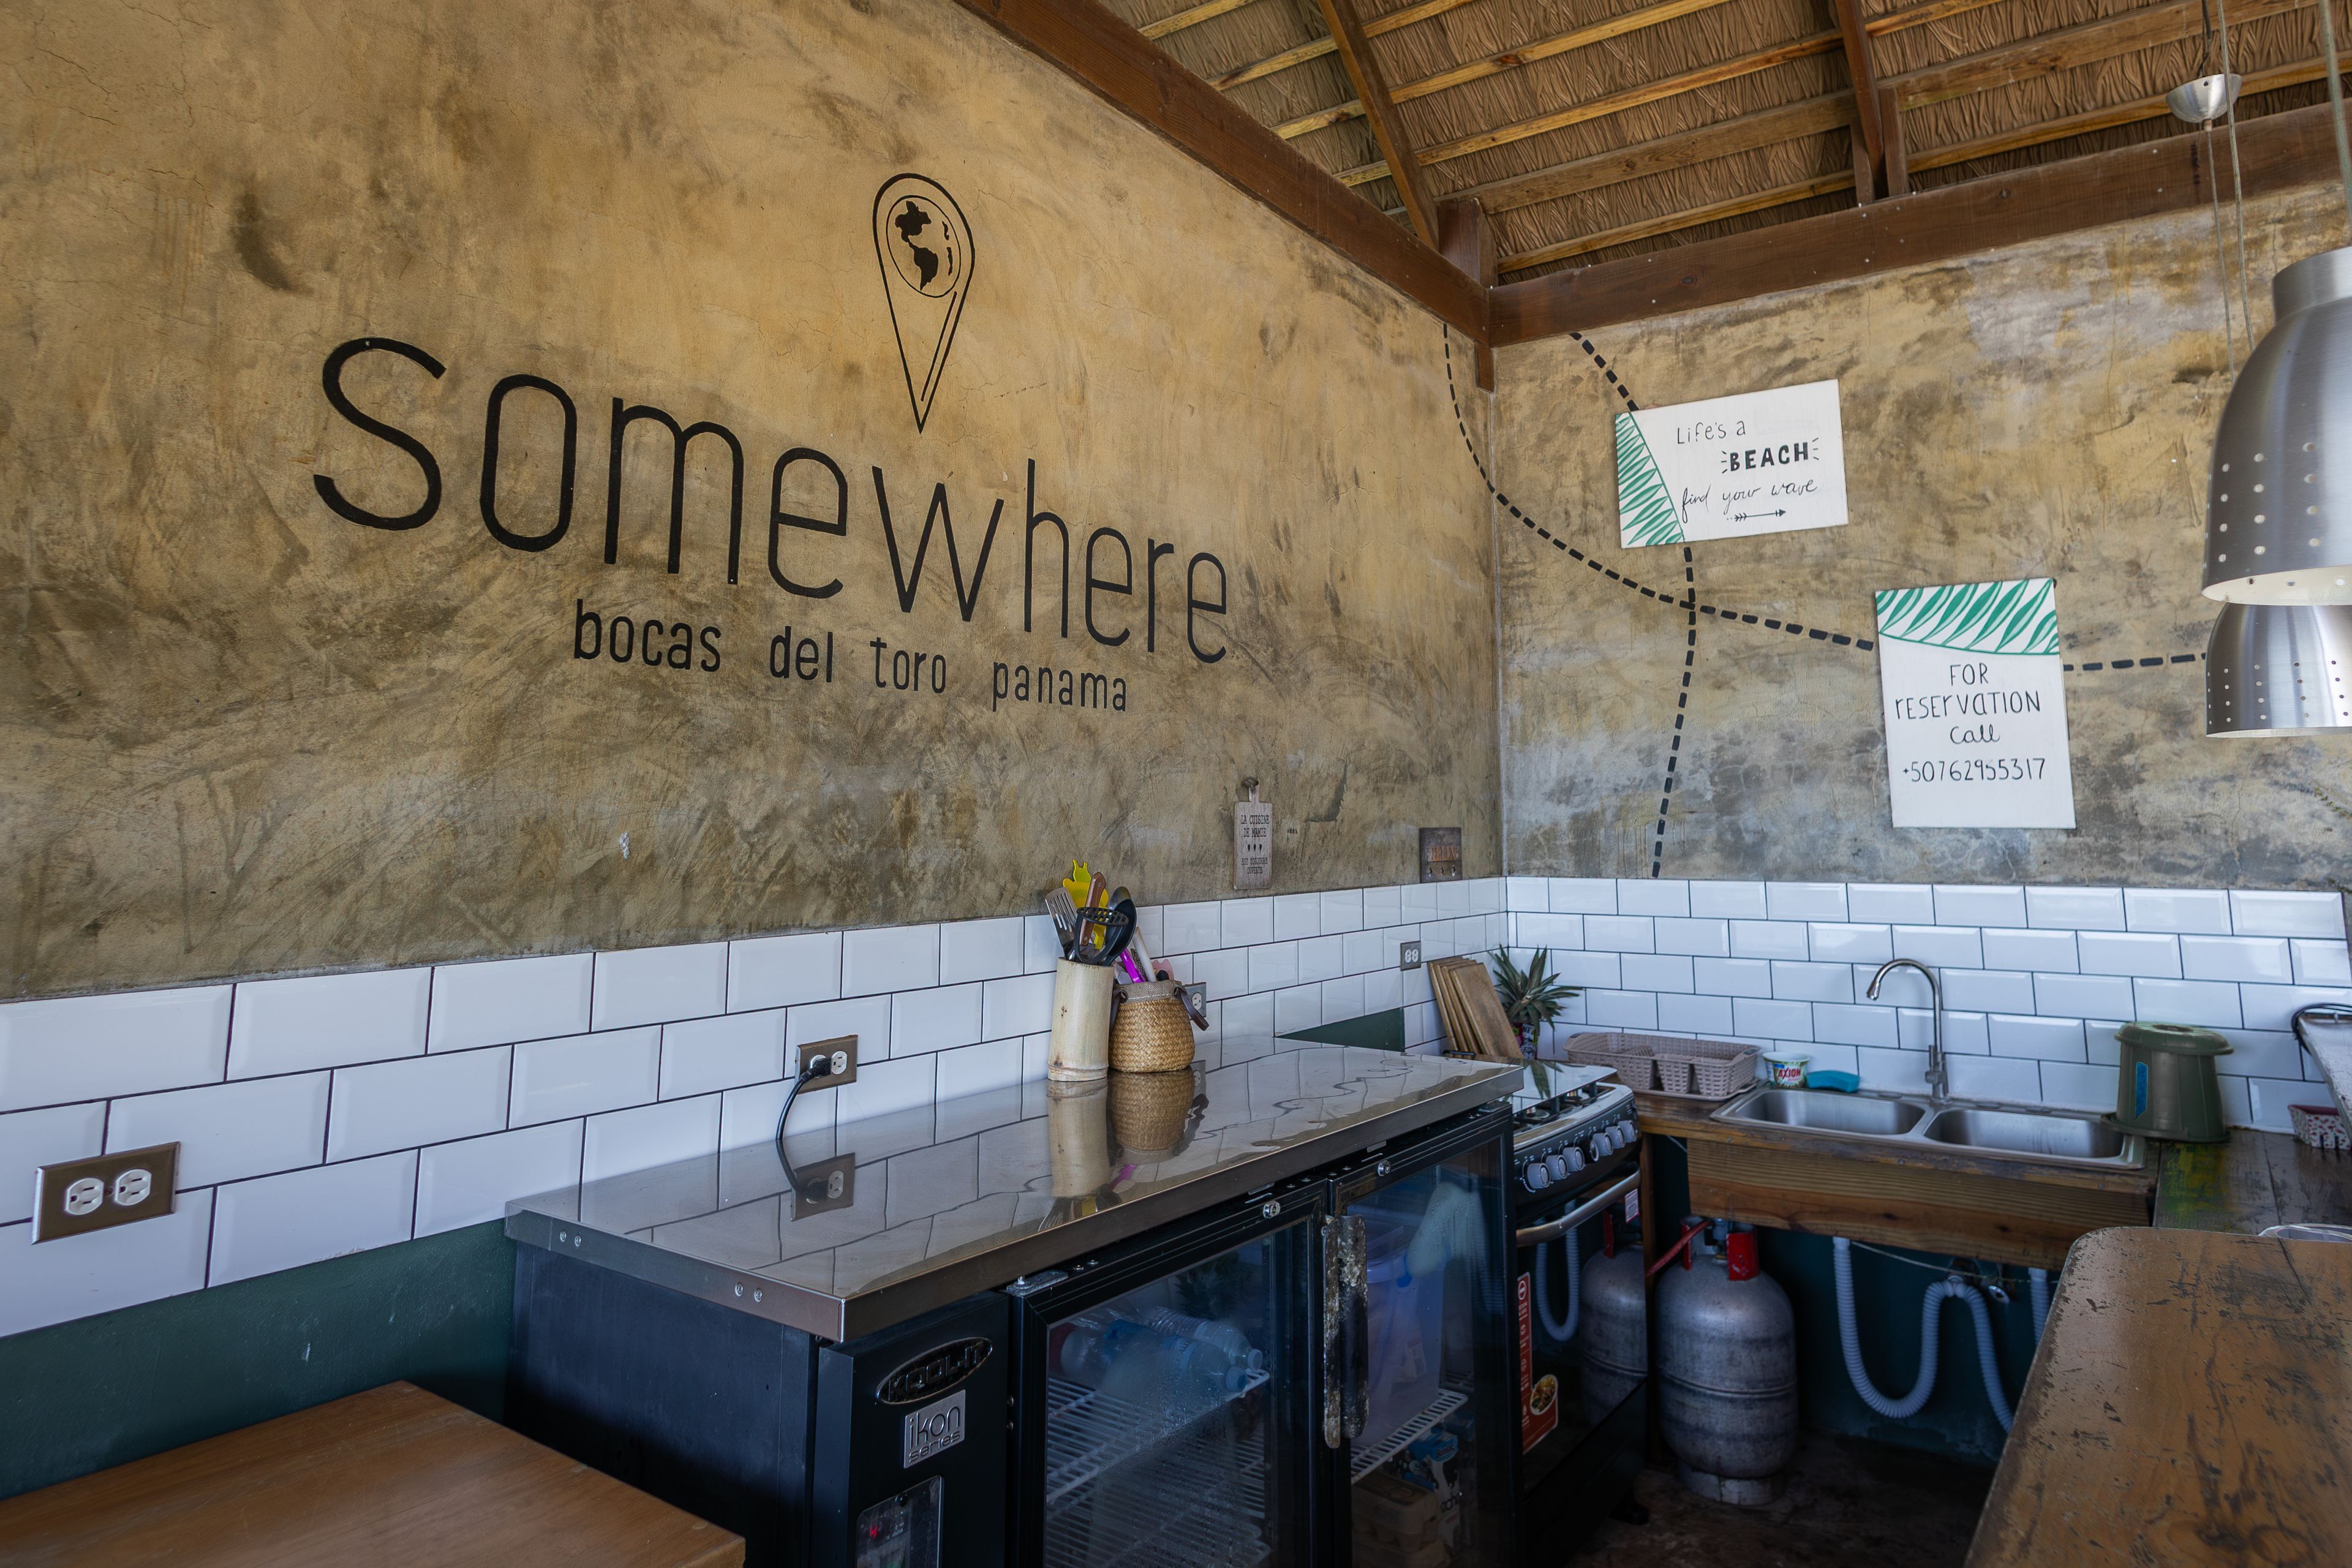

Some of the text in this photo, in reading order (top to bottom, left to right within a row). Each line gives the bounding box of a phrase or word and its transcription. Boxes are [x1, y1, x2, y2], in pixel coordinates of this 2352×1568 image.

[1677, 421, 1746, 444] Life's a
[1730, 442, 1809, 472] BEACH
[313, 337, 1227, 664] somewhere
[1682, 478, 1818, 524] find your wave
[573, 598, 1126, 712] bocas del toro panama
[1950, 663, 1989, 686] FOR
[1903, 758, 2045, 782] +50762955317
[1241, 815, 1270, 824] LA CUISINE
[1243, 827, 1267, 837] DE MAMIE
[1777, 1068, 1801, 1080] AXION
[910, 1406, 960, 1450] ikon
[908, 1430, 960, 1463] series
